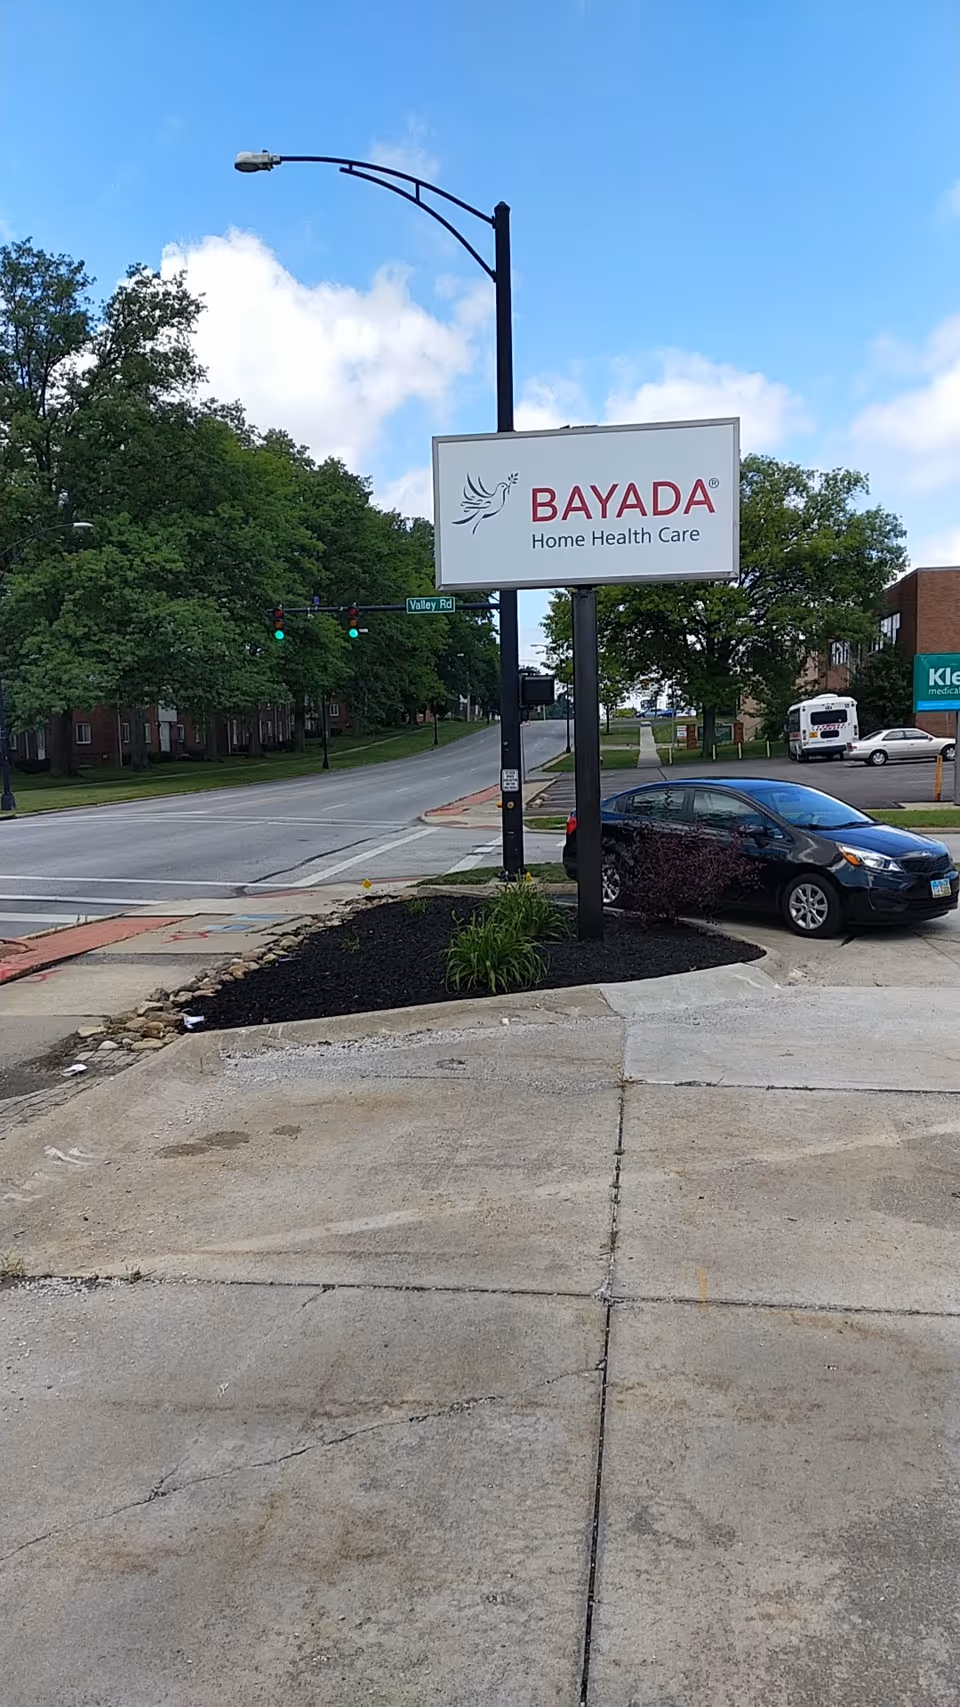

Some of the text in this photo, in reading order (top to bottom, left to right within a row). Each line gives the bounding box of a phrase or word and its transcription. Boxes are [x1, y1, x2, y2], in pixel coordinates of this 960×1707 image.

[532, 527, 701, 549] Home Health Care
[409, 598, 452, 611] Valley Rd
